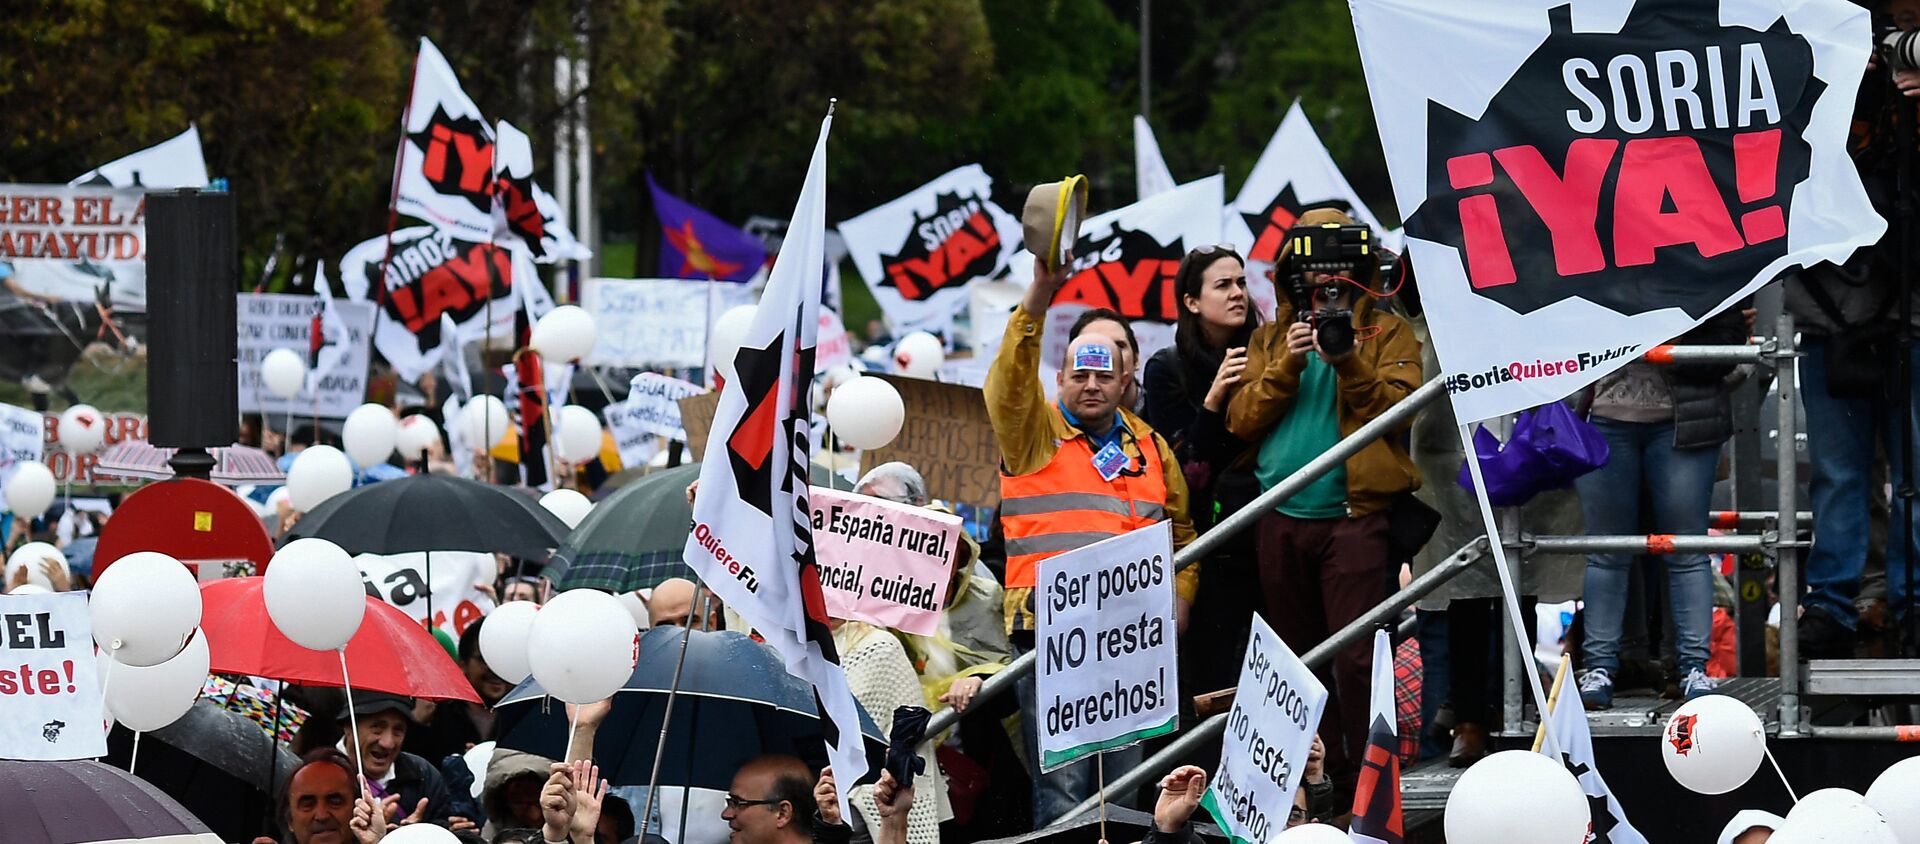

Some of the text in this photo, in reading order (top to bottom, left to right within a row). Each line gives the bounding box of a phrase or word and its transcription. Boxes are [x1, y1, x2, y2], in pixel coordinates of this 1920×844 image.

[1562, 42, 1781, 134] SORIA
[73, 197, 123, 225] EL
[1446, 128, 1786, 289] ¡YA!
[0, 230, 147, 260] ATAYUD
[828, 505, 894, 543] España
[898, 529, 950, 566] rural,
[870, 574, 938, 612] cuidad.
[1047, 554, 1163, 626] ¡Ser pocos
[1046, 612, 1163, 676] NO resta
[1047, 667, 1165, 737] derechos!
[1248, 632, 1310, 732] Ser pocos
[1229, 702, 1293, 793] no resta
